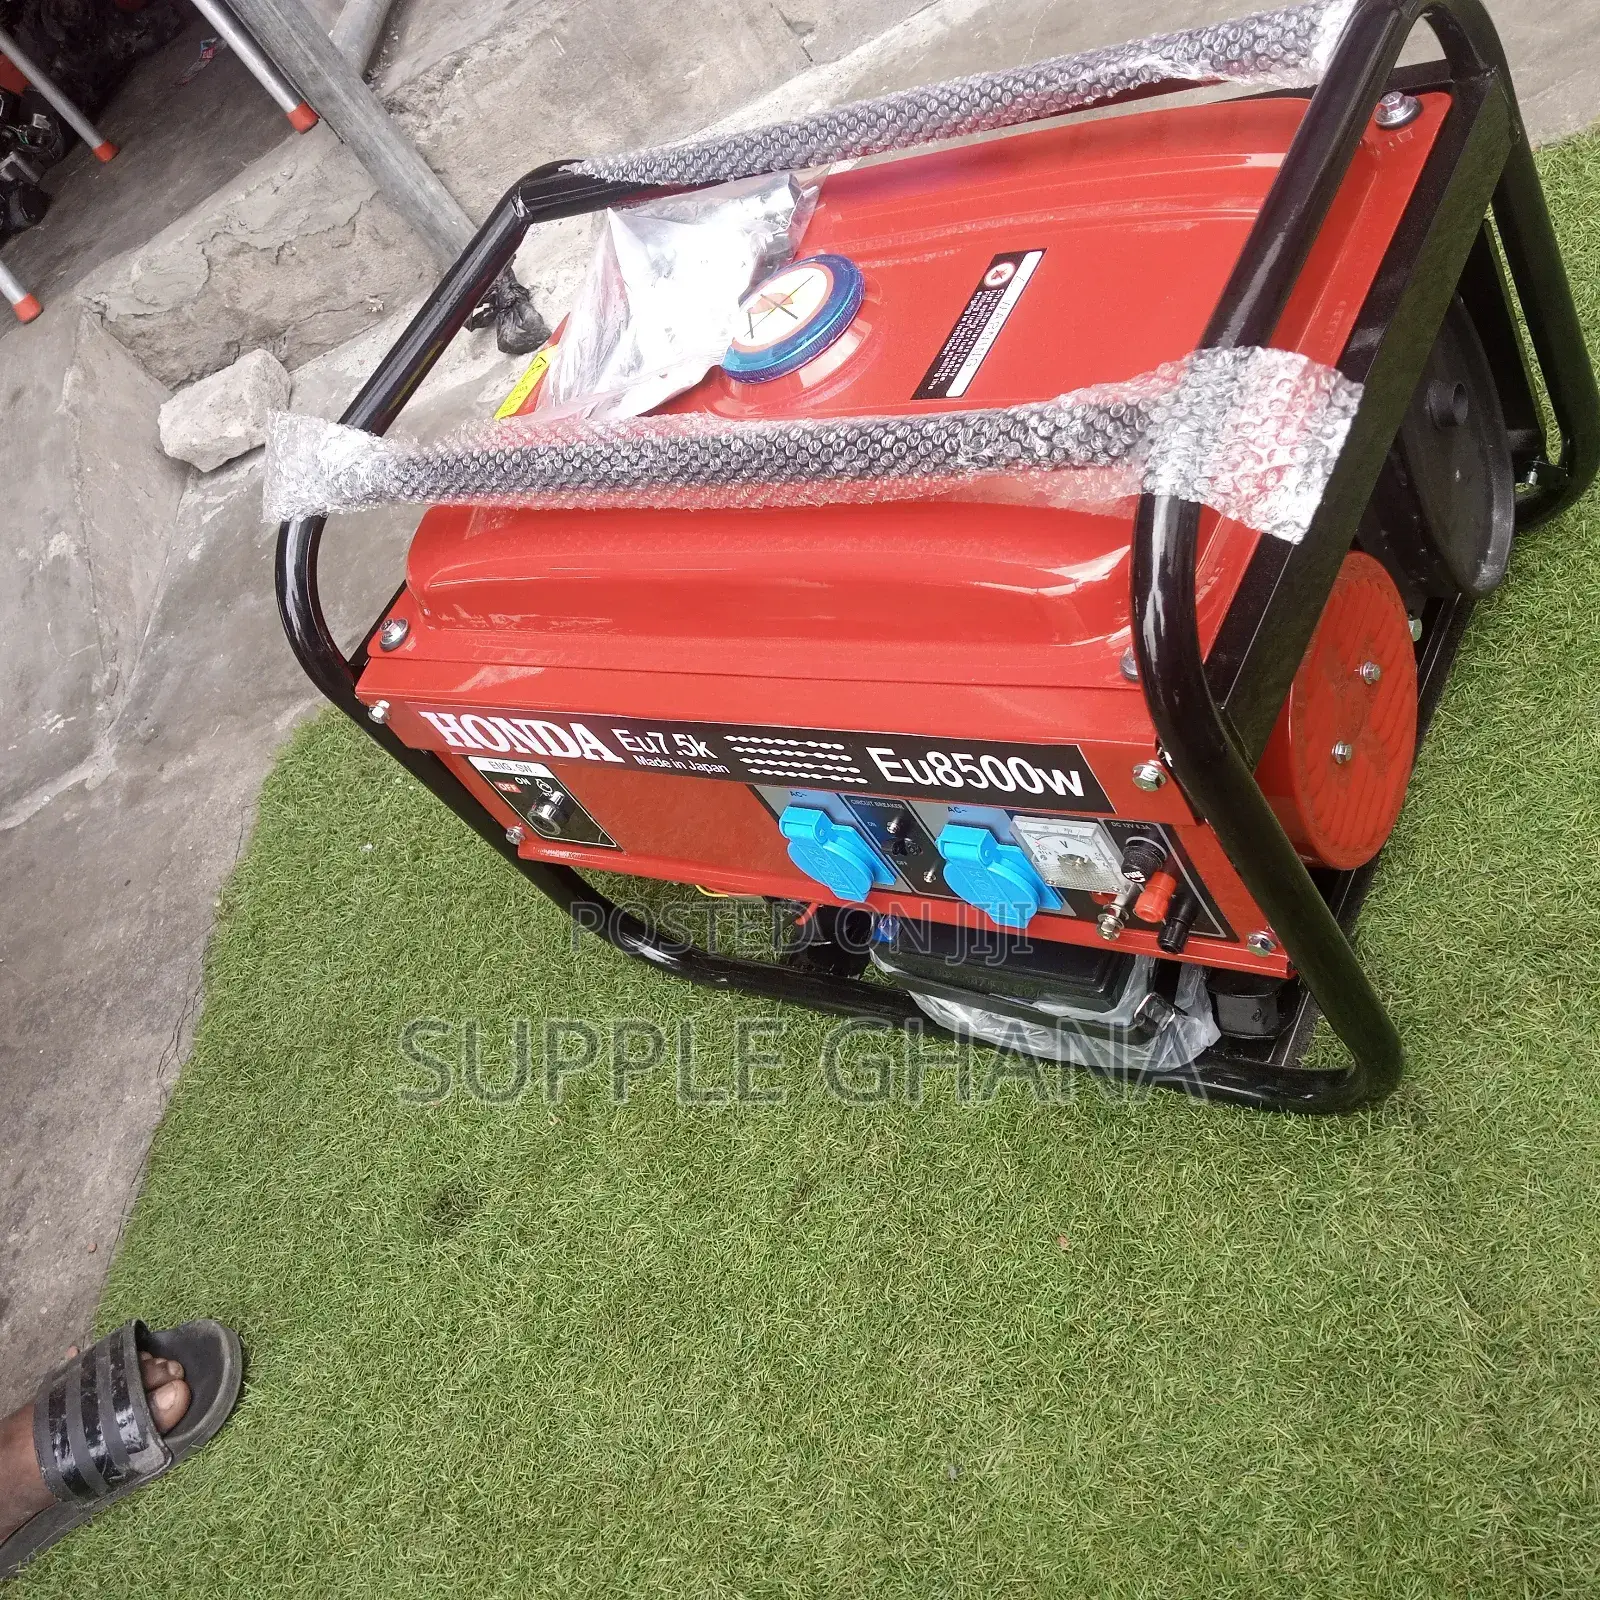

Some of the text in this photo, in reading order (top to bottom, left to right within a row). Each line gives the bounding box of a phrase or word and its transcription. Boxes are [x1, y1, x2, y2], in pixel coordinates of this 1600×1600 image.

[984, 289, 998, 302] fuel
[986, 288, 1005, 310] Check
[964, 312, 978, 326] fuel
[964, 299, 1013, 367] WARNING
[418, 711, 625, 762] HONDA
[866, 746, 1085, 797] Eu8500w
[632, 755, 731, 775] Made in Japan
[498, 783, 518, 792] OFF
[514, 777, 531, 786] ON
[850, 799, 905, 810] CIRCUIT BREAKER
[1060, 840, 1069, 849] V
[1124, 870, 1144, 879] FUSE
